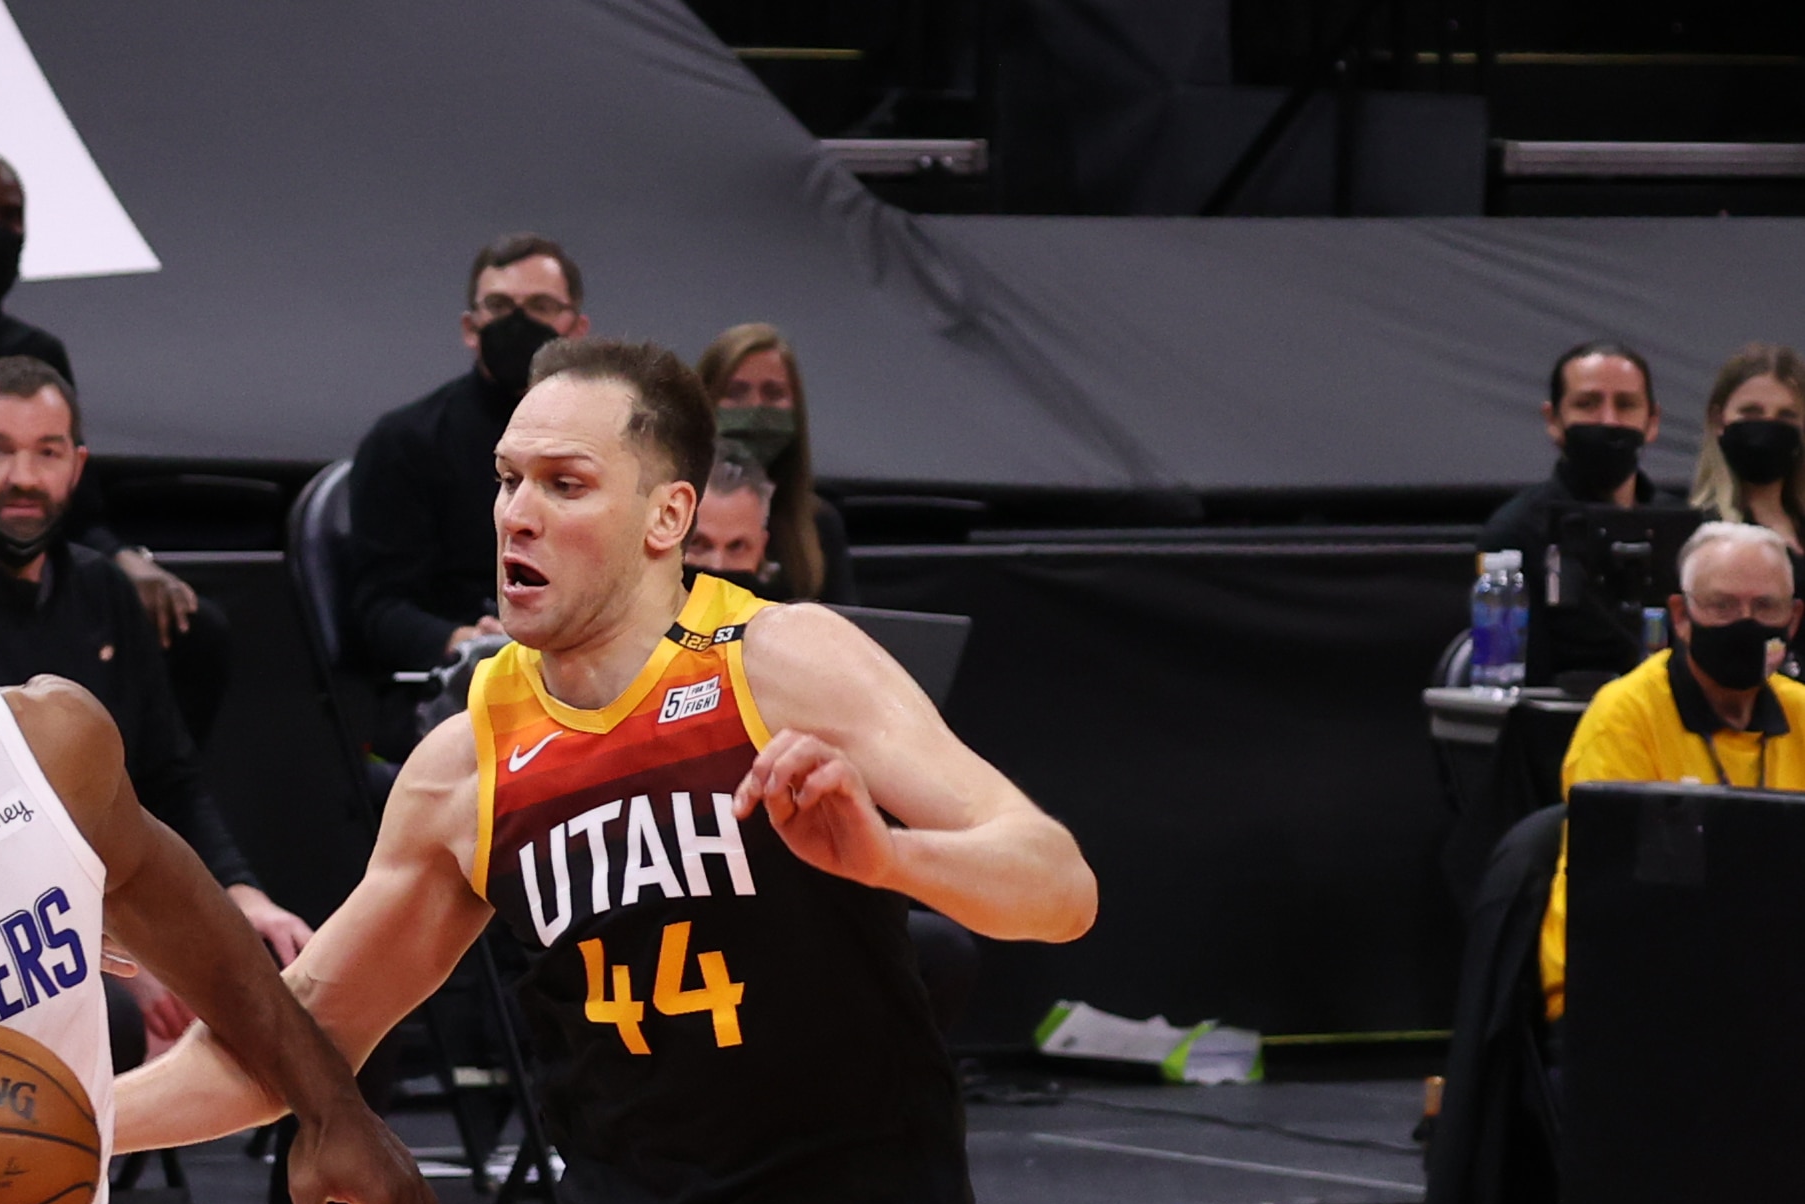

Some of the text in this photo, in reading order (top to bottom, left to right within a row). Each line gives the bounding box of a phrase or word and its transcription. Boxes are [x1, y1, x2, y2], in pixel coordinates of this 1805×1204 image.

[714, 627, 735, 643] 53
[665, 690, 683, 719] 5
[692, 685, 704, 694] FOR
[684, 693, 717, 714] FIGHT
[518, 791, 757, 948] UTAH
[576, 920, 745, 1055] 44
